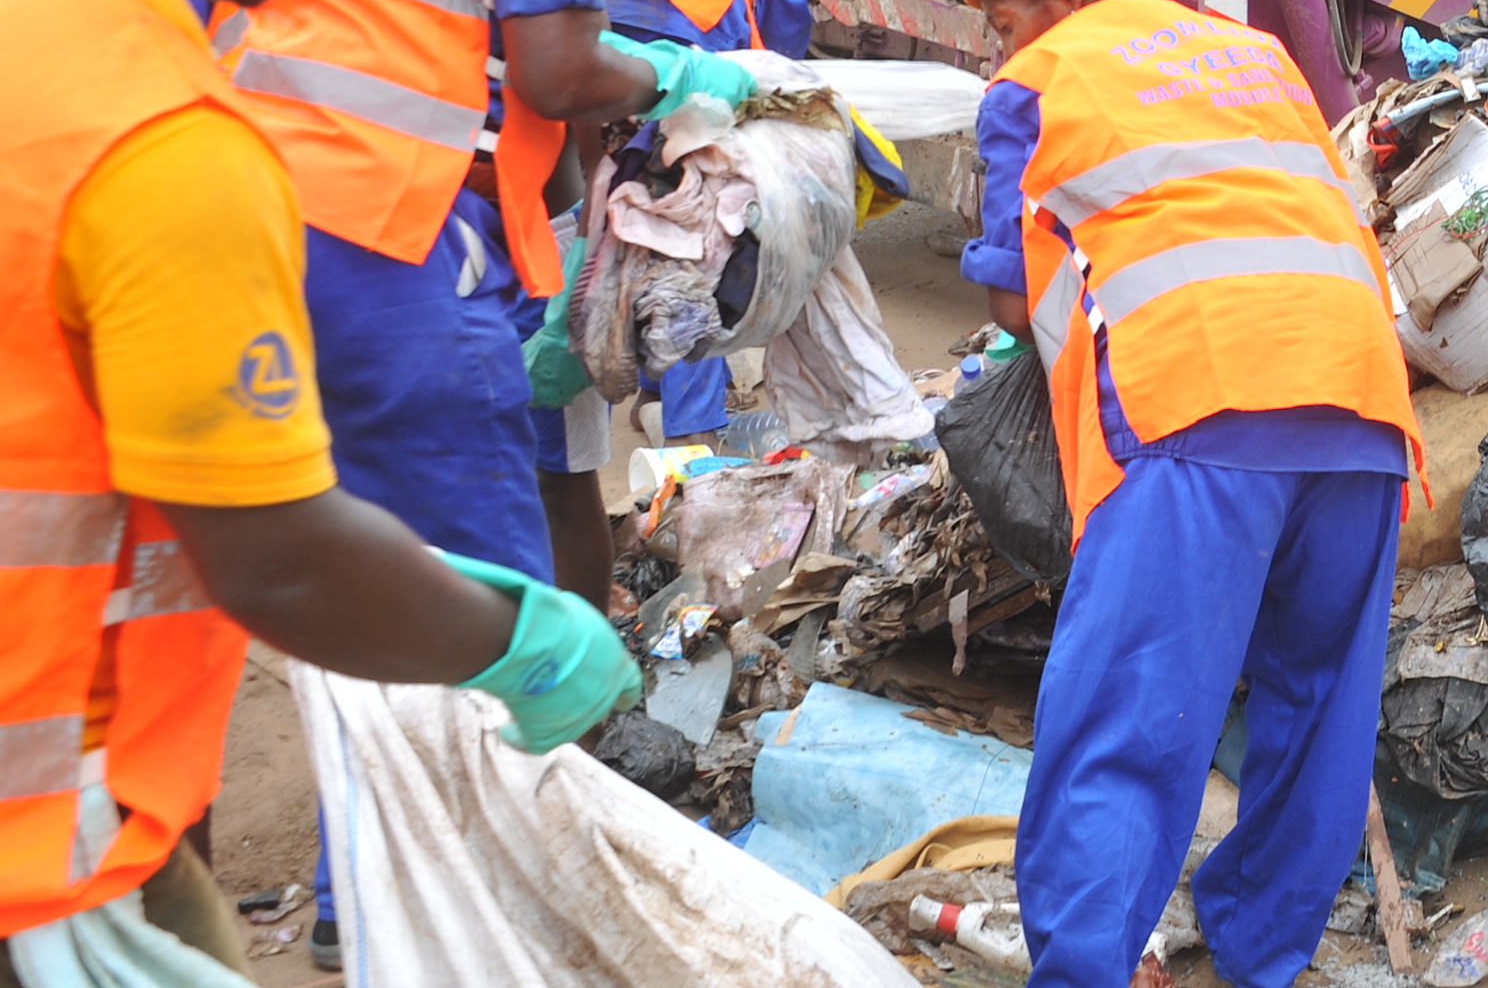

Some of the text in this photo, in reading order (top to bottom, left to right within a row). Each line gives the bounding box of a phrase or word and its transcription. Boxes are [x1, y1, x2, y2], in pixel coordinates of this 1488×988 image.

[1157, 45, 1284, 76] GYEEDA
[1137, 78, 1205, 105] WASTE
[1210, 86, 1284, 108] MODULE
